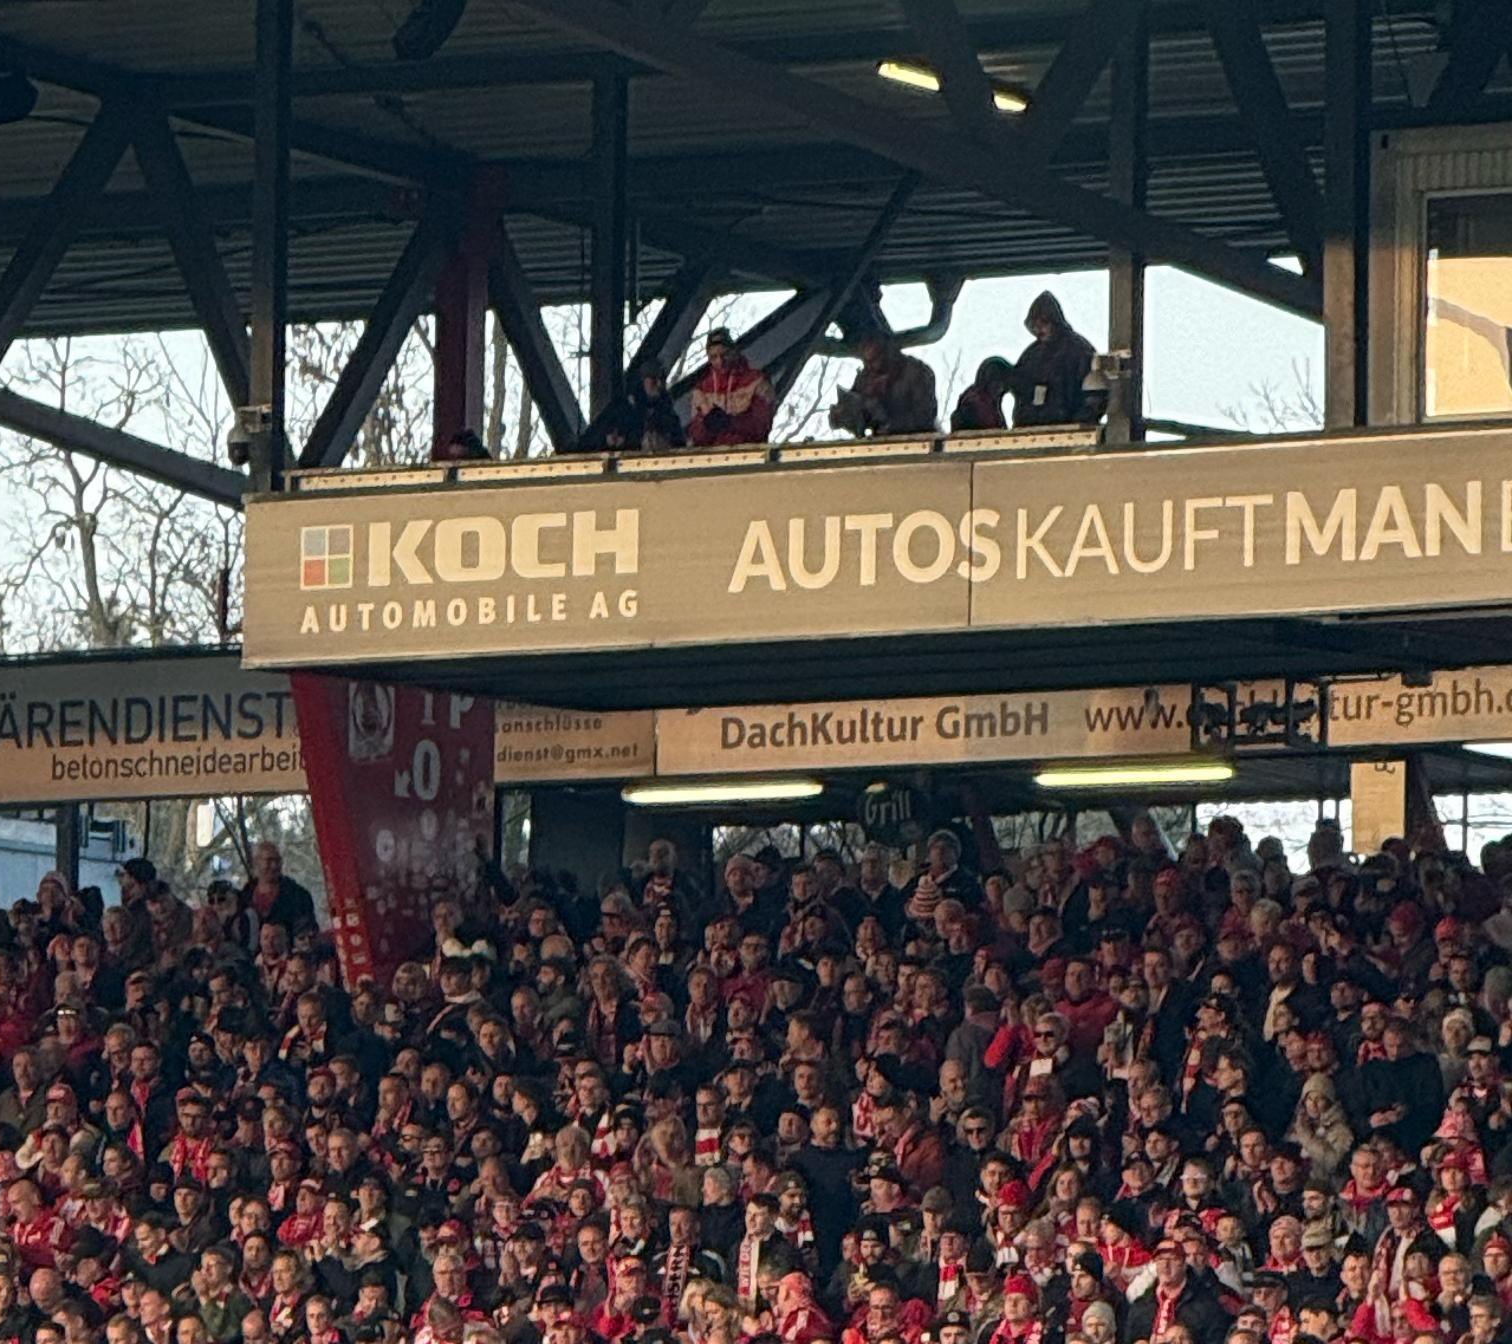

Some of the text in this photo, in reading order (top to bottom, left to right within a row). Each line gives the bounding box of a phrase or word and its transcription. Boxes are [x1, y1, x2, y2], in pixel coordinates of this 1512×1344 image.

[368, 509, 639, 587] KOCH
[300, 589, 638, 634] AUTOMOBILE AG
[721, 701, 1049, 750] DachKultur GmbH
